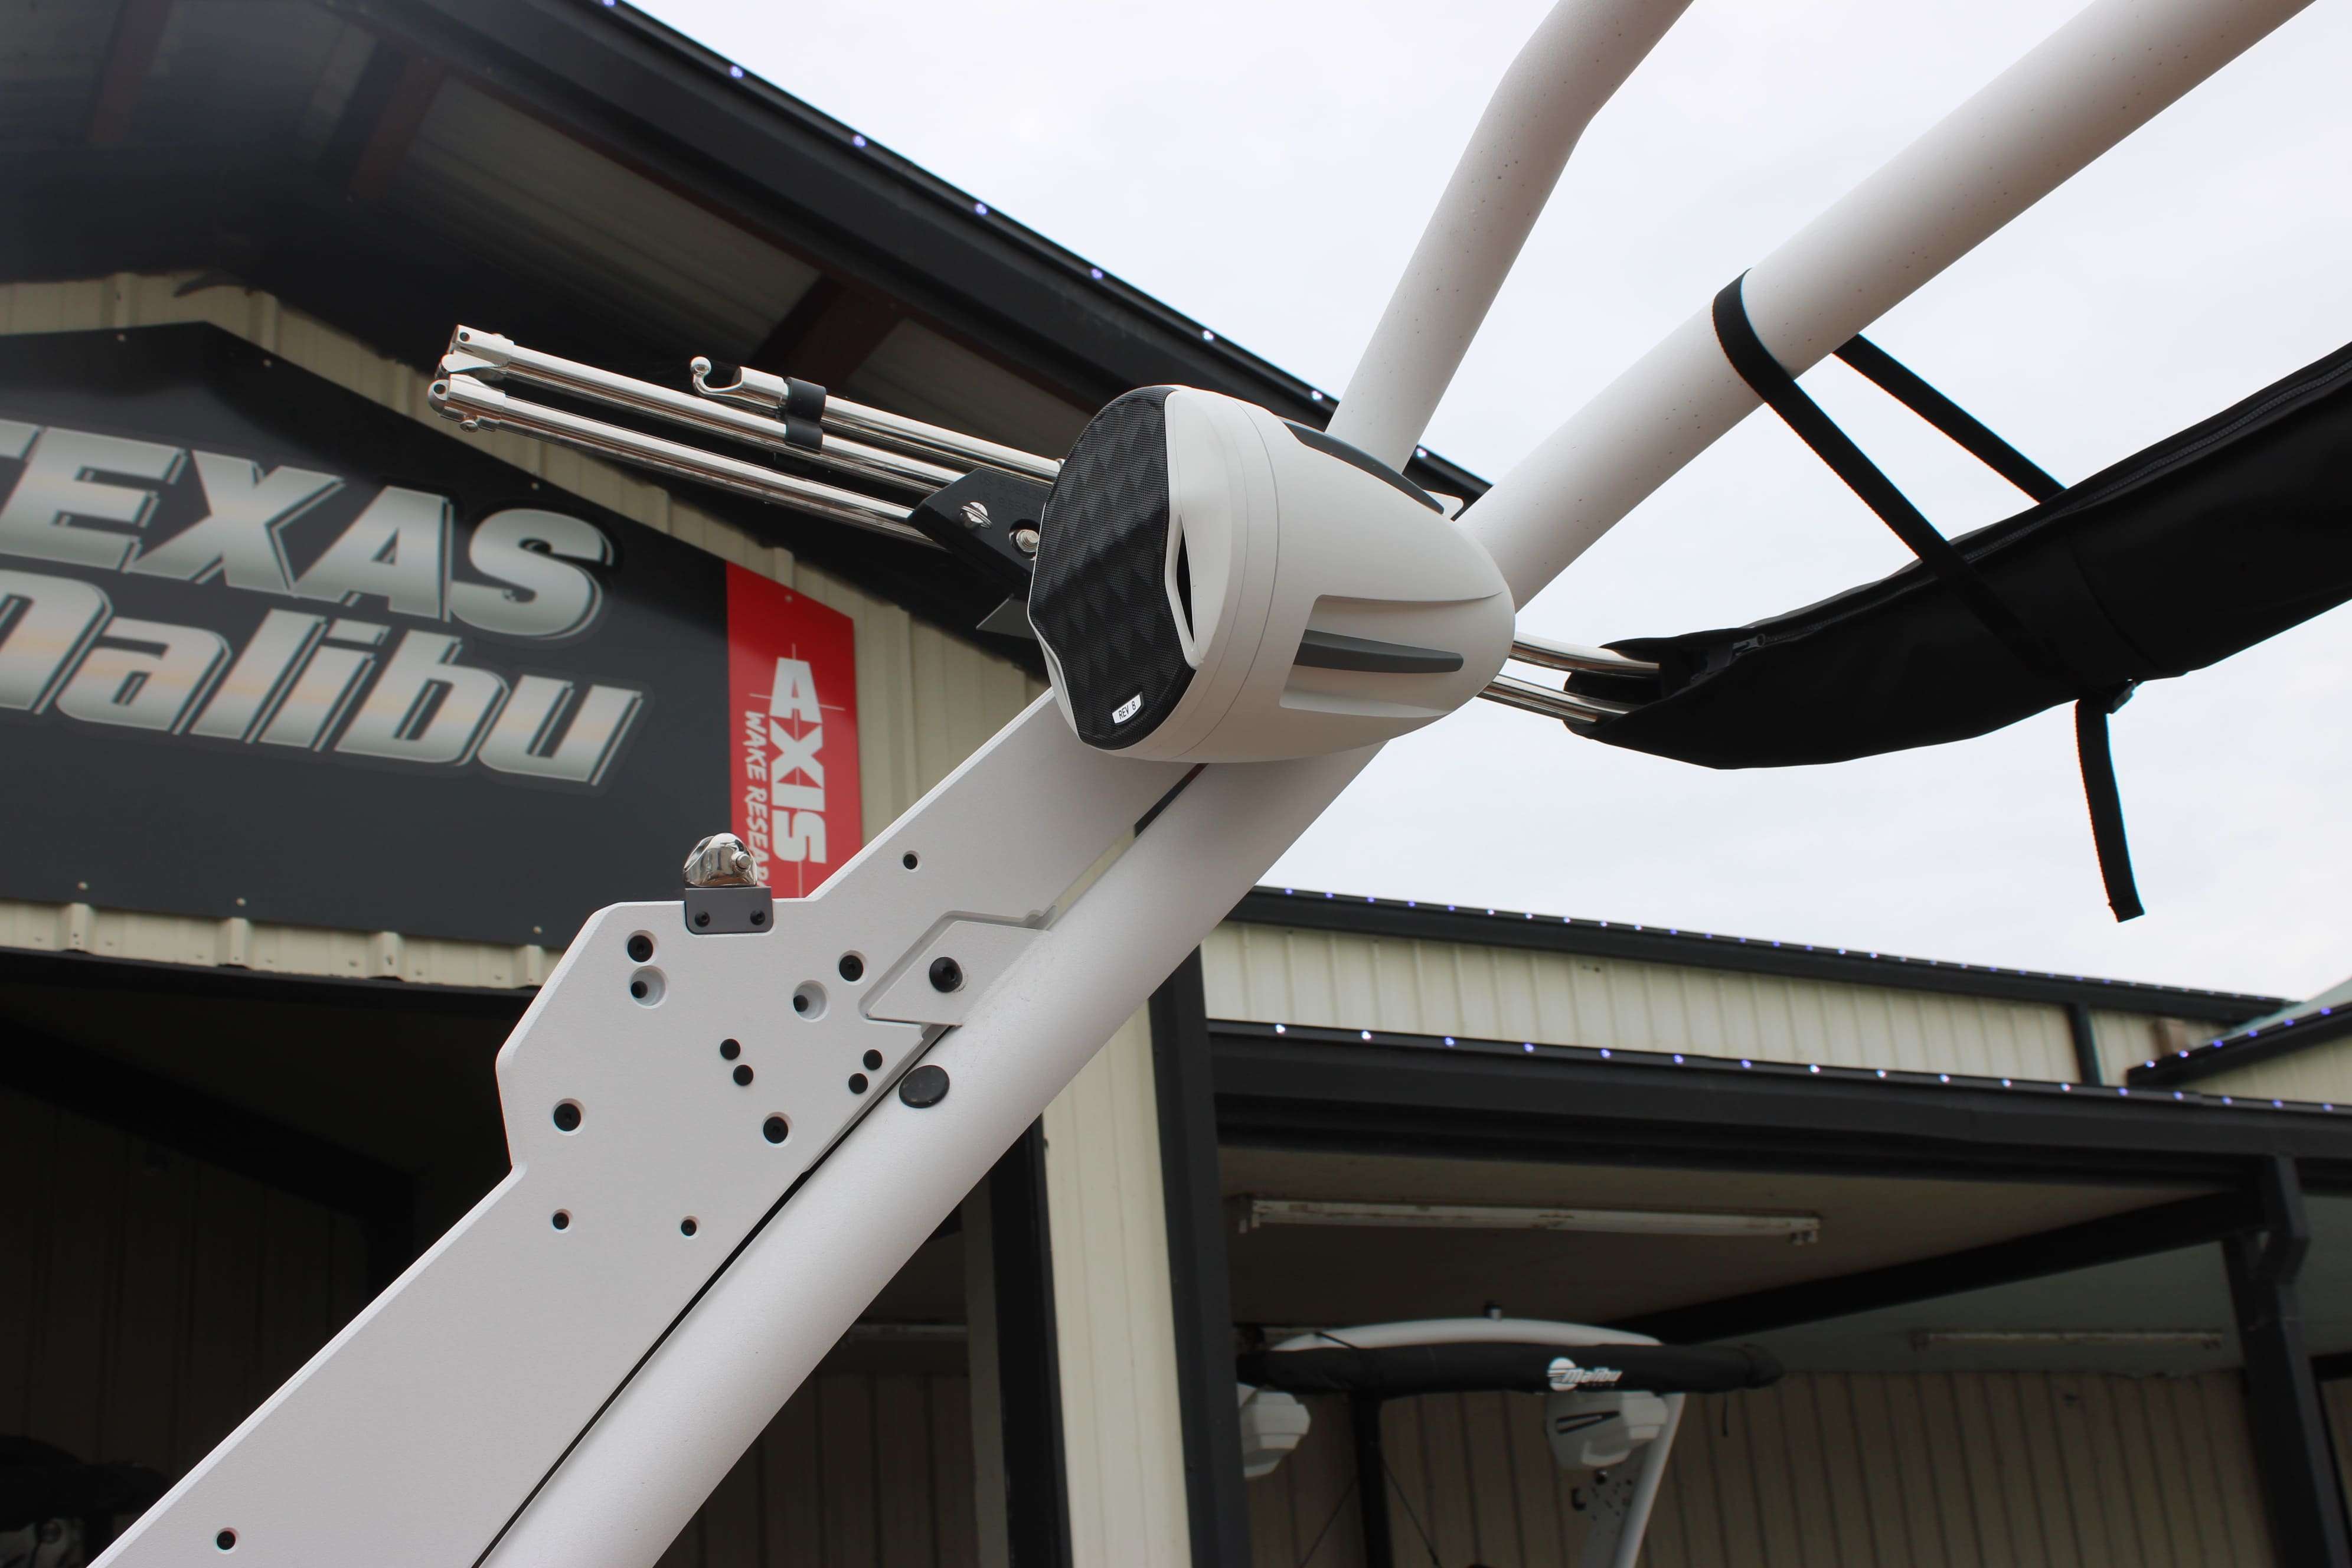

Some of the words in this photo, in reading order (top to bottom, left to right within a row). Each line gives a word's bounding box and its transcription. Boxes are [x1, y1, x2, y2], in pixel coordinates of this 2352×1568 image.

[743, 710, 767, 782] WAKE
[1119, 705, 1129, 719] REV
[1132, 701, 1136, 710] 8
[770, 657, 826, 864] AXIS
[744, 785, 770, 887] RESEAR
